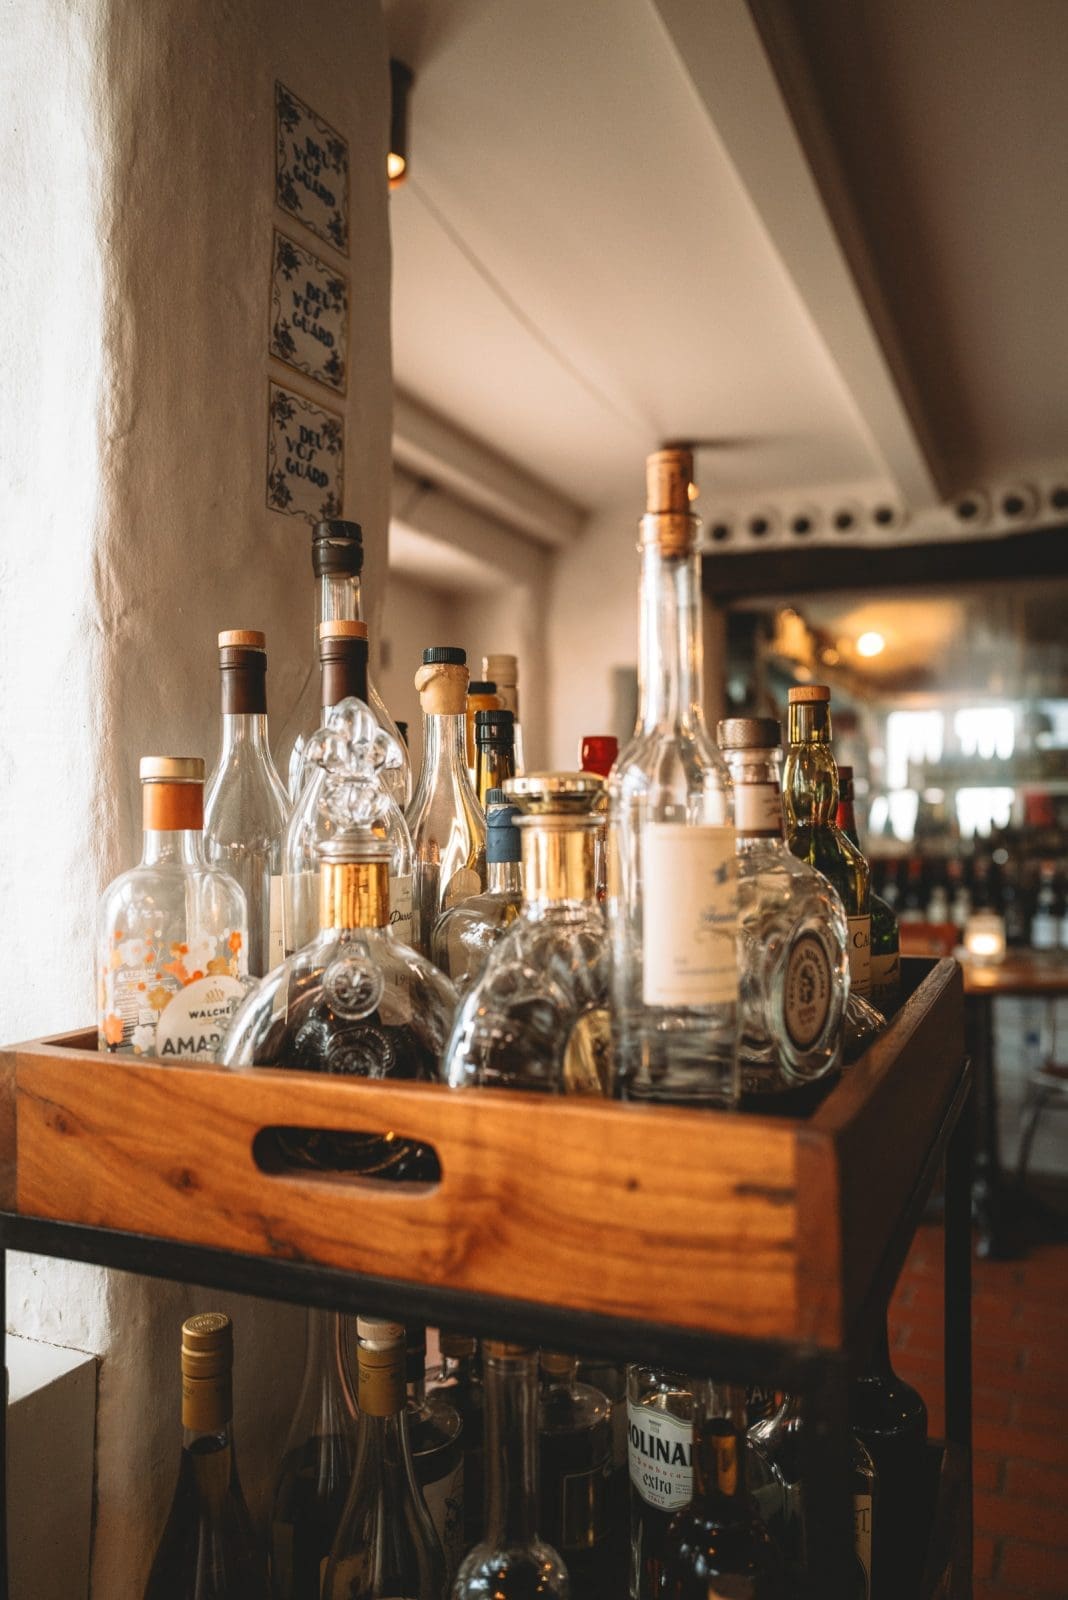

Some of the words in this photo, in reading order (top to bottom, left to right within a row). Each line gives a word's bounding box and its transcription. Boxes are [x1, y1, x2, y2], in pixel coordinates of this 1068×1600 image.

[292, 312, 335, 347] GUARD
[285, 457, 329, 488] GUARD
[643, 1472, 672, 1495] extra
